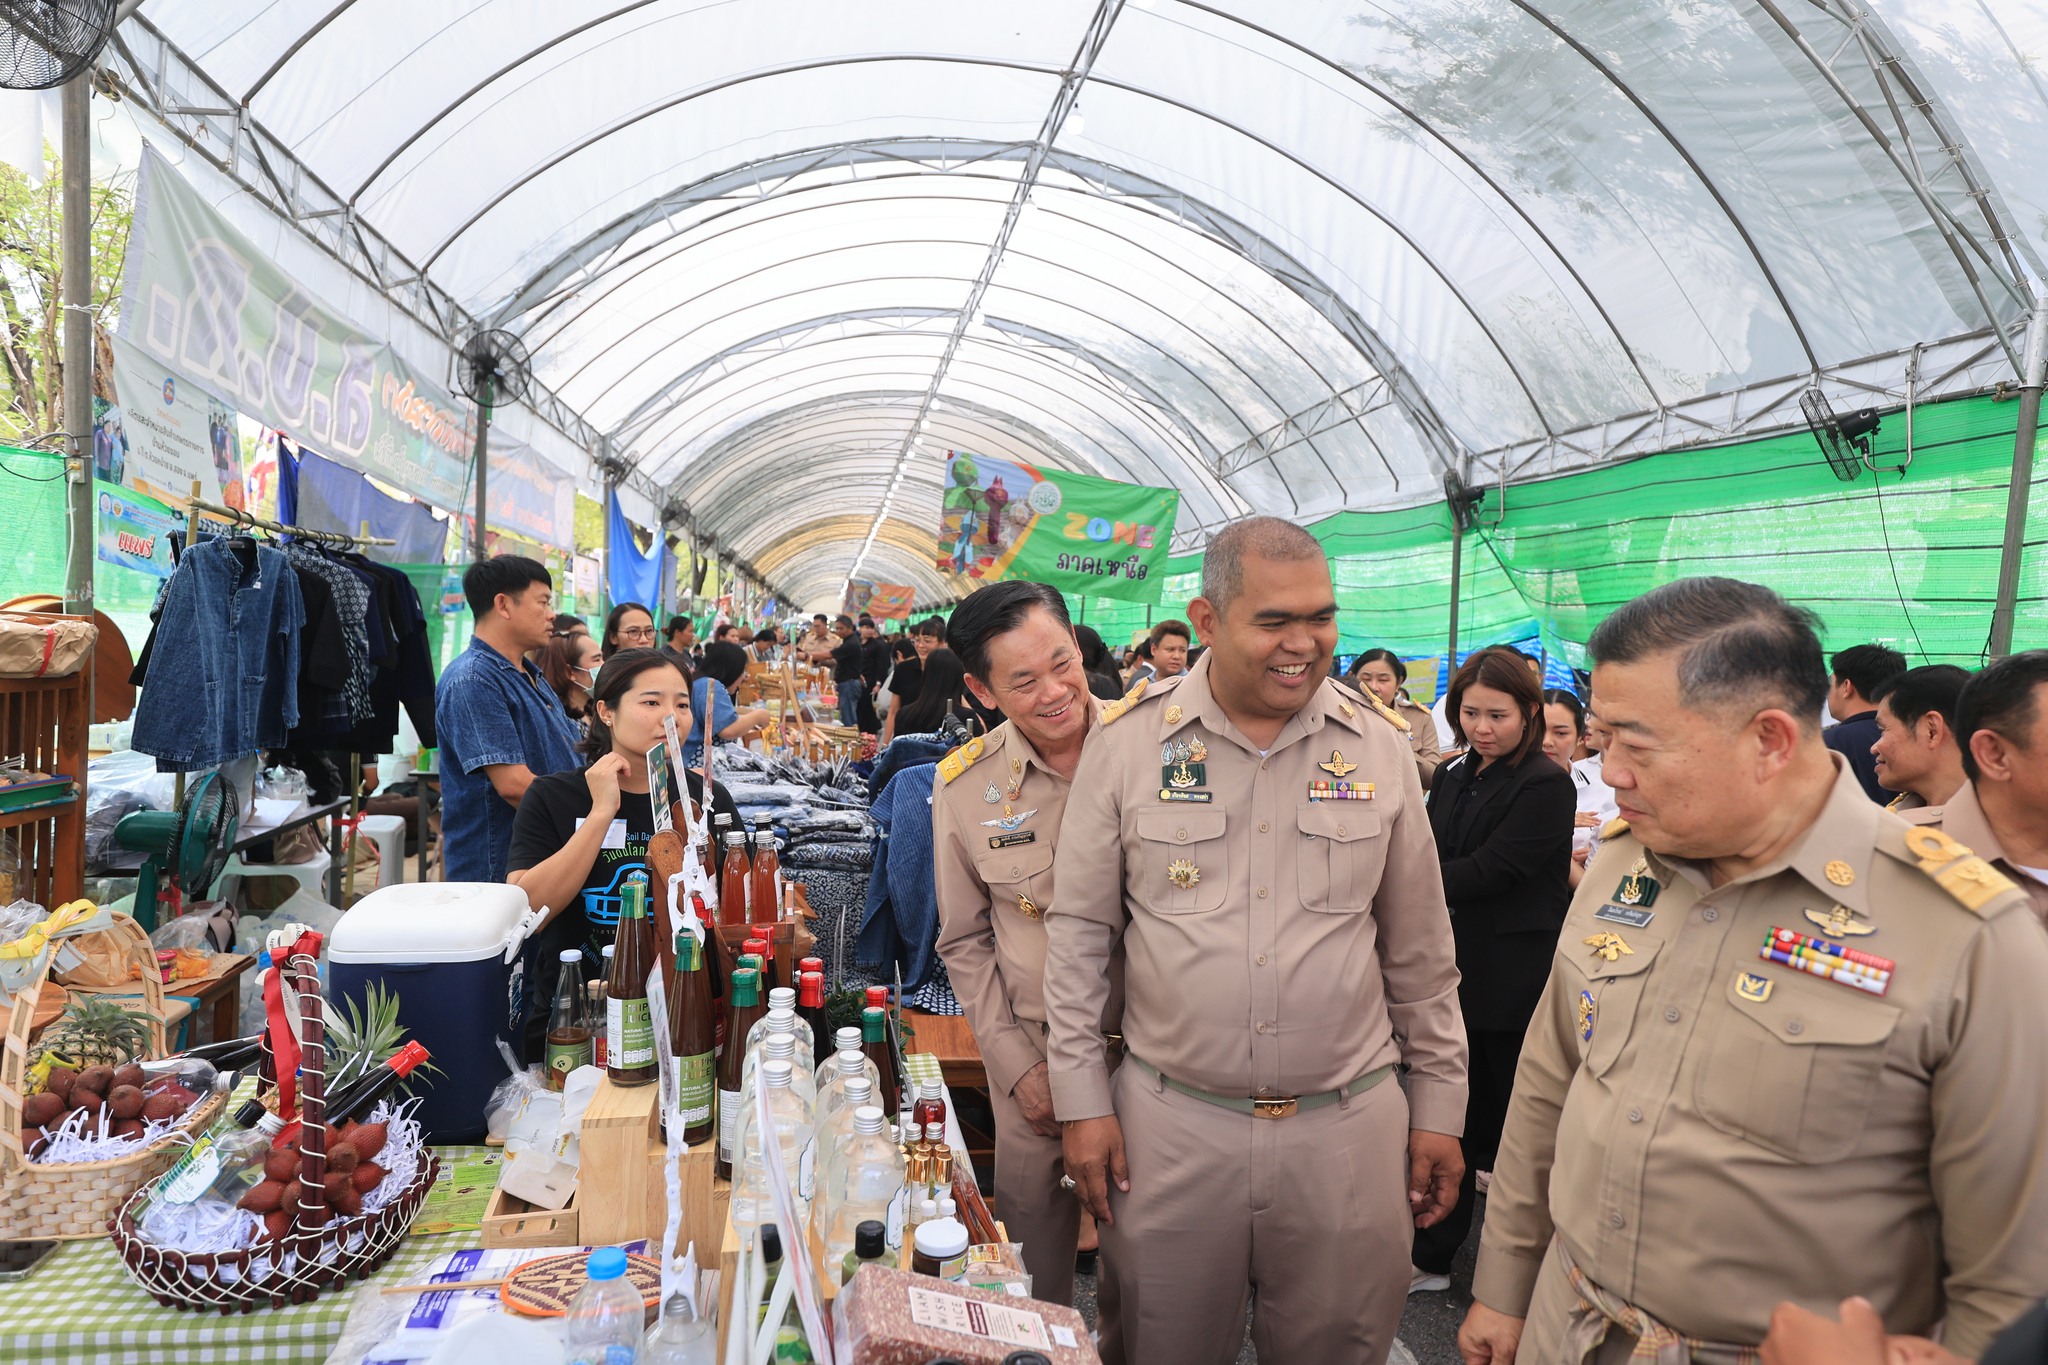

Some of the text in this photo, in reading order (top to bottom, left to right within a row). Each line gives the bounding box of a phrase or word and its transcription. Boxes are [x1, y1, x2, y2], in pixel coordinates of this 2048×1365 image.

[1063, 512, 1156, 549] ZONE
[1056, 553, 1148, 580] ภาคเหนือ
[625, 1002, 649, 1013] TRIP
